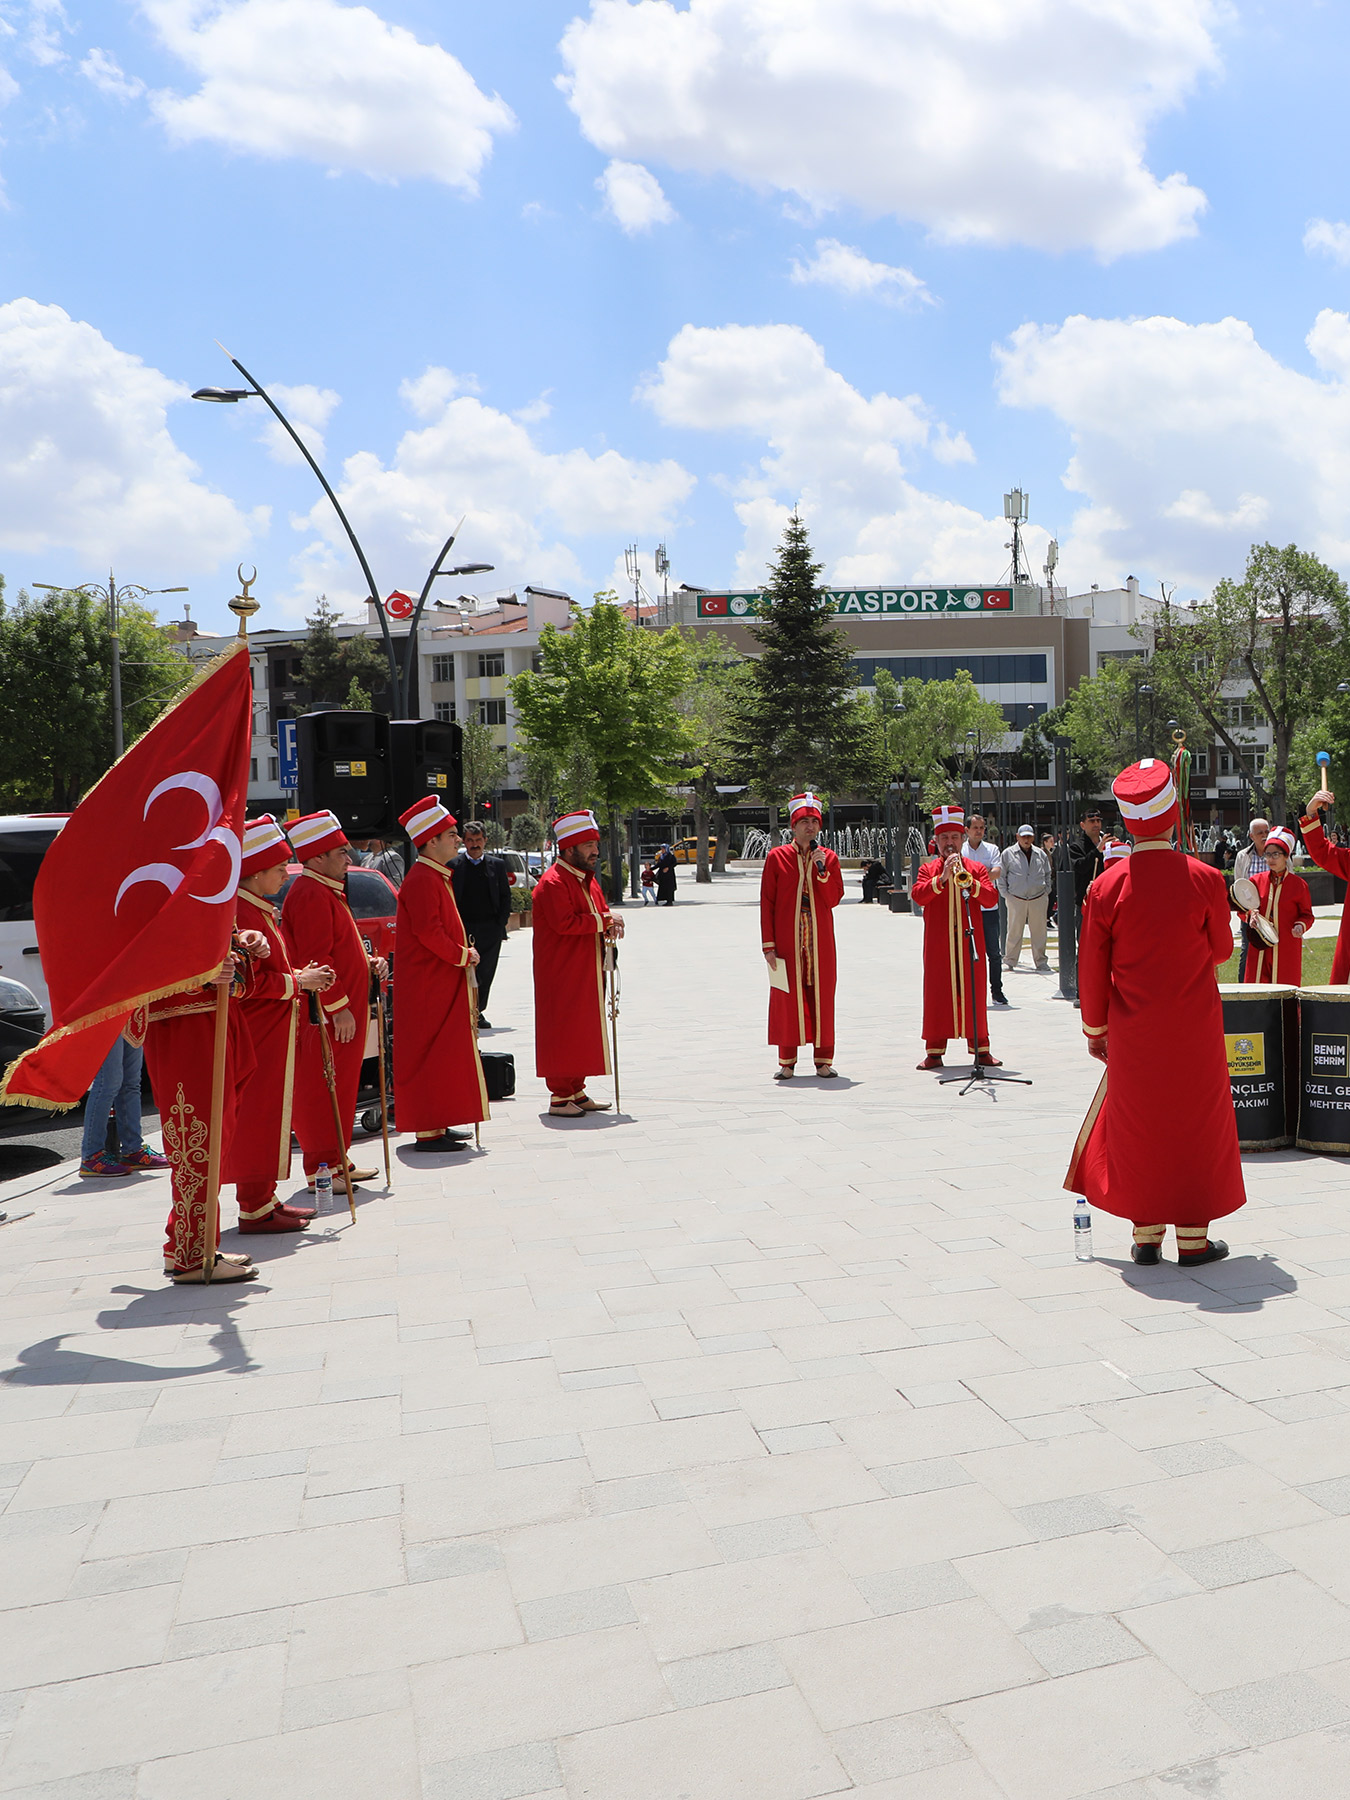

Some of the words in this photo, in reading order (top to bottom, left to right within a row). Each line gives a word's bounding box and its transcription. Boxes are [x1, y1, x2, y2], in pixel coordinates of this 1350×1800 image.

[1314, 1044, 1346, 1056] BENİM
[1314, 1056, 1346, 1066] ŞEHRİM
[1230, 1082, 1275, 1097] NÇLER
[1305, 1081, 1332, 1095] ÖZEL
[1232, 1098, 1269, 1108] TAKIMI
